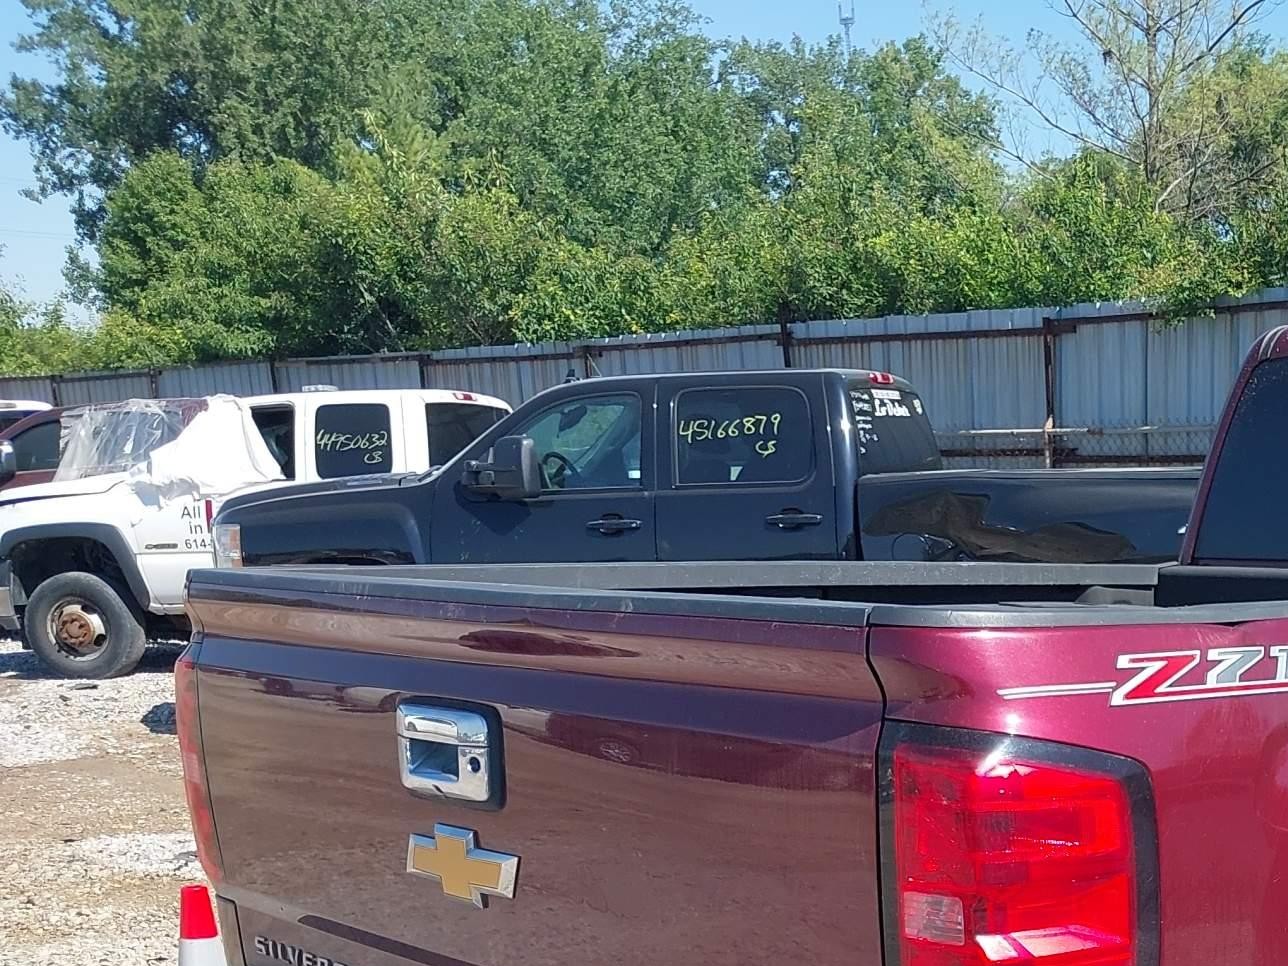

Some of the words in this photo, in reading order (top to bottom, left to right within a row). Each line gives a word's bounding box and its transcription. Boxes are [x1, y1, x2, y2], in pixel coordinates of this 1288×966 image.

[679, 413, 781, 444] 45166879
[181, 505, 201, 519] All
[188, 521, 203, 534] in
[184, 538, 213, 550] 614-
